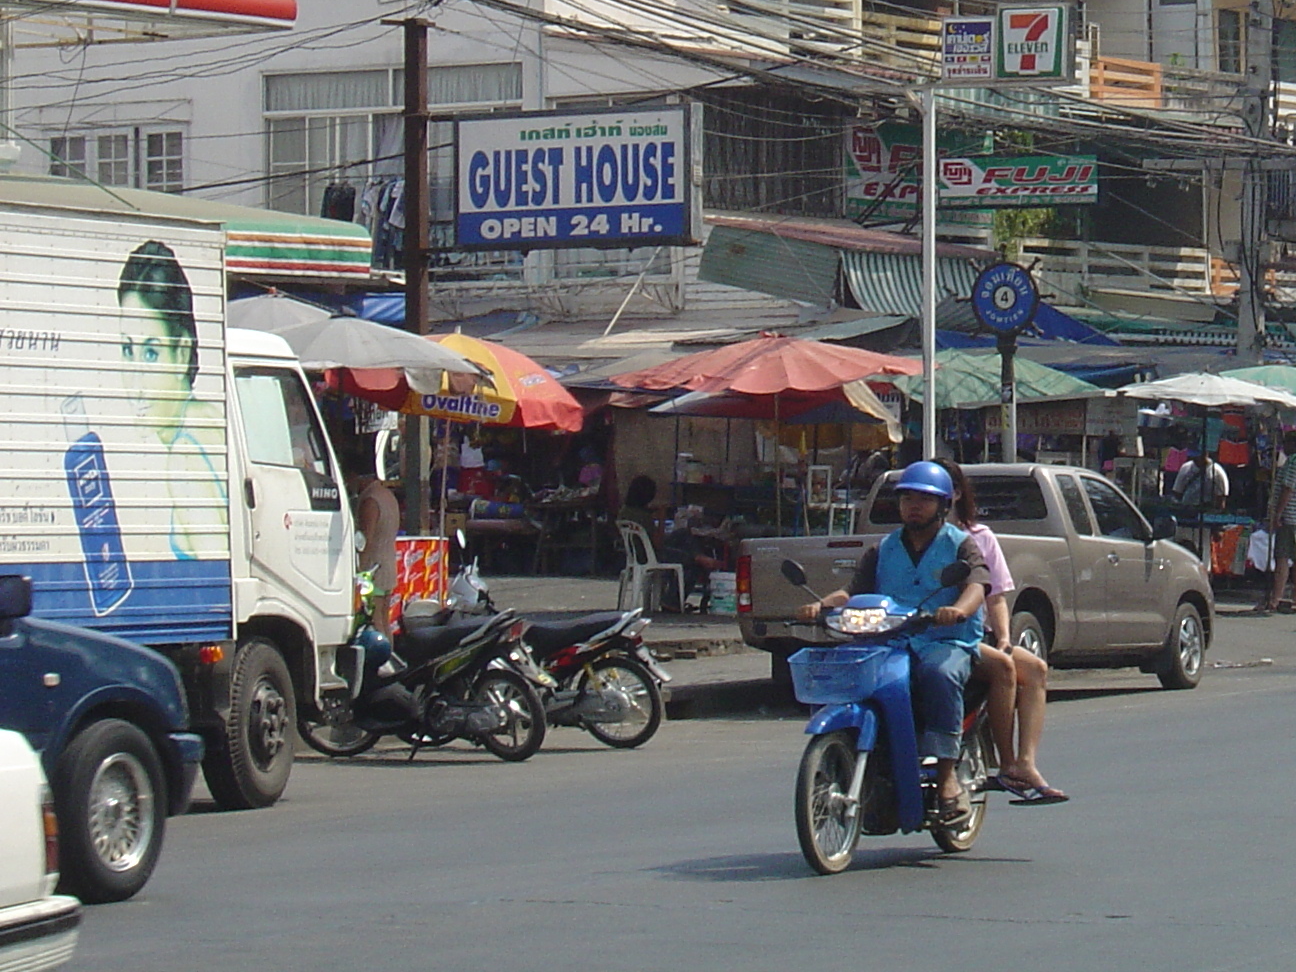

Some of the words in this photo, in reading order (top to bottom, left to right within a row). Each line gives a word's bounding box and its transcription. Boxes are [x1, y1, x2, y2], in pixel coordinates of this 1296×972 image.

[469, 147, 565, 209] GUEST
[574, 141, 676, 205] HOUSE
[982, 165, 1093, 184] FUJI
[480, 216, 557, 240] OPEN
[569, 214, 610, 236] 24
[620, 212, 663, 234] Hr.
[1000, 290, 1009, 304] 4
[422, 393, 500, 418] Ovaltine
[312, 488, 338, 500] HINO
